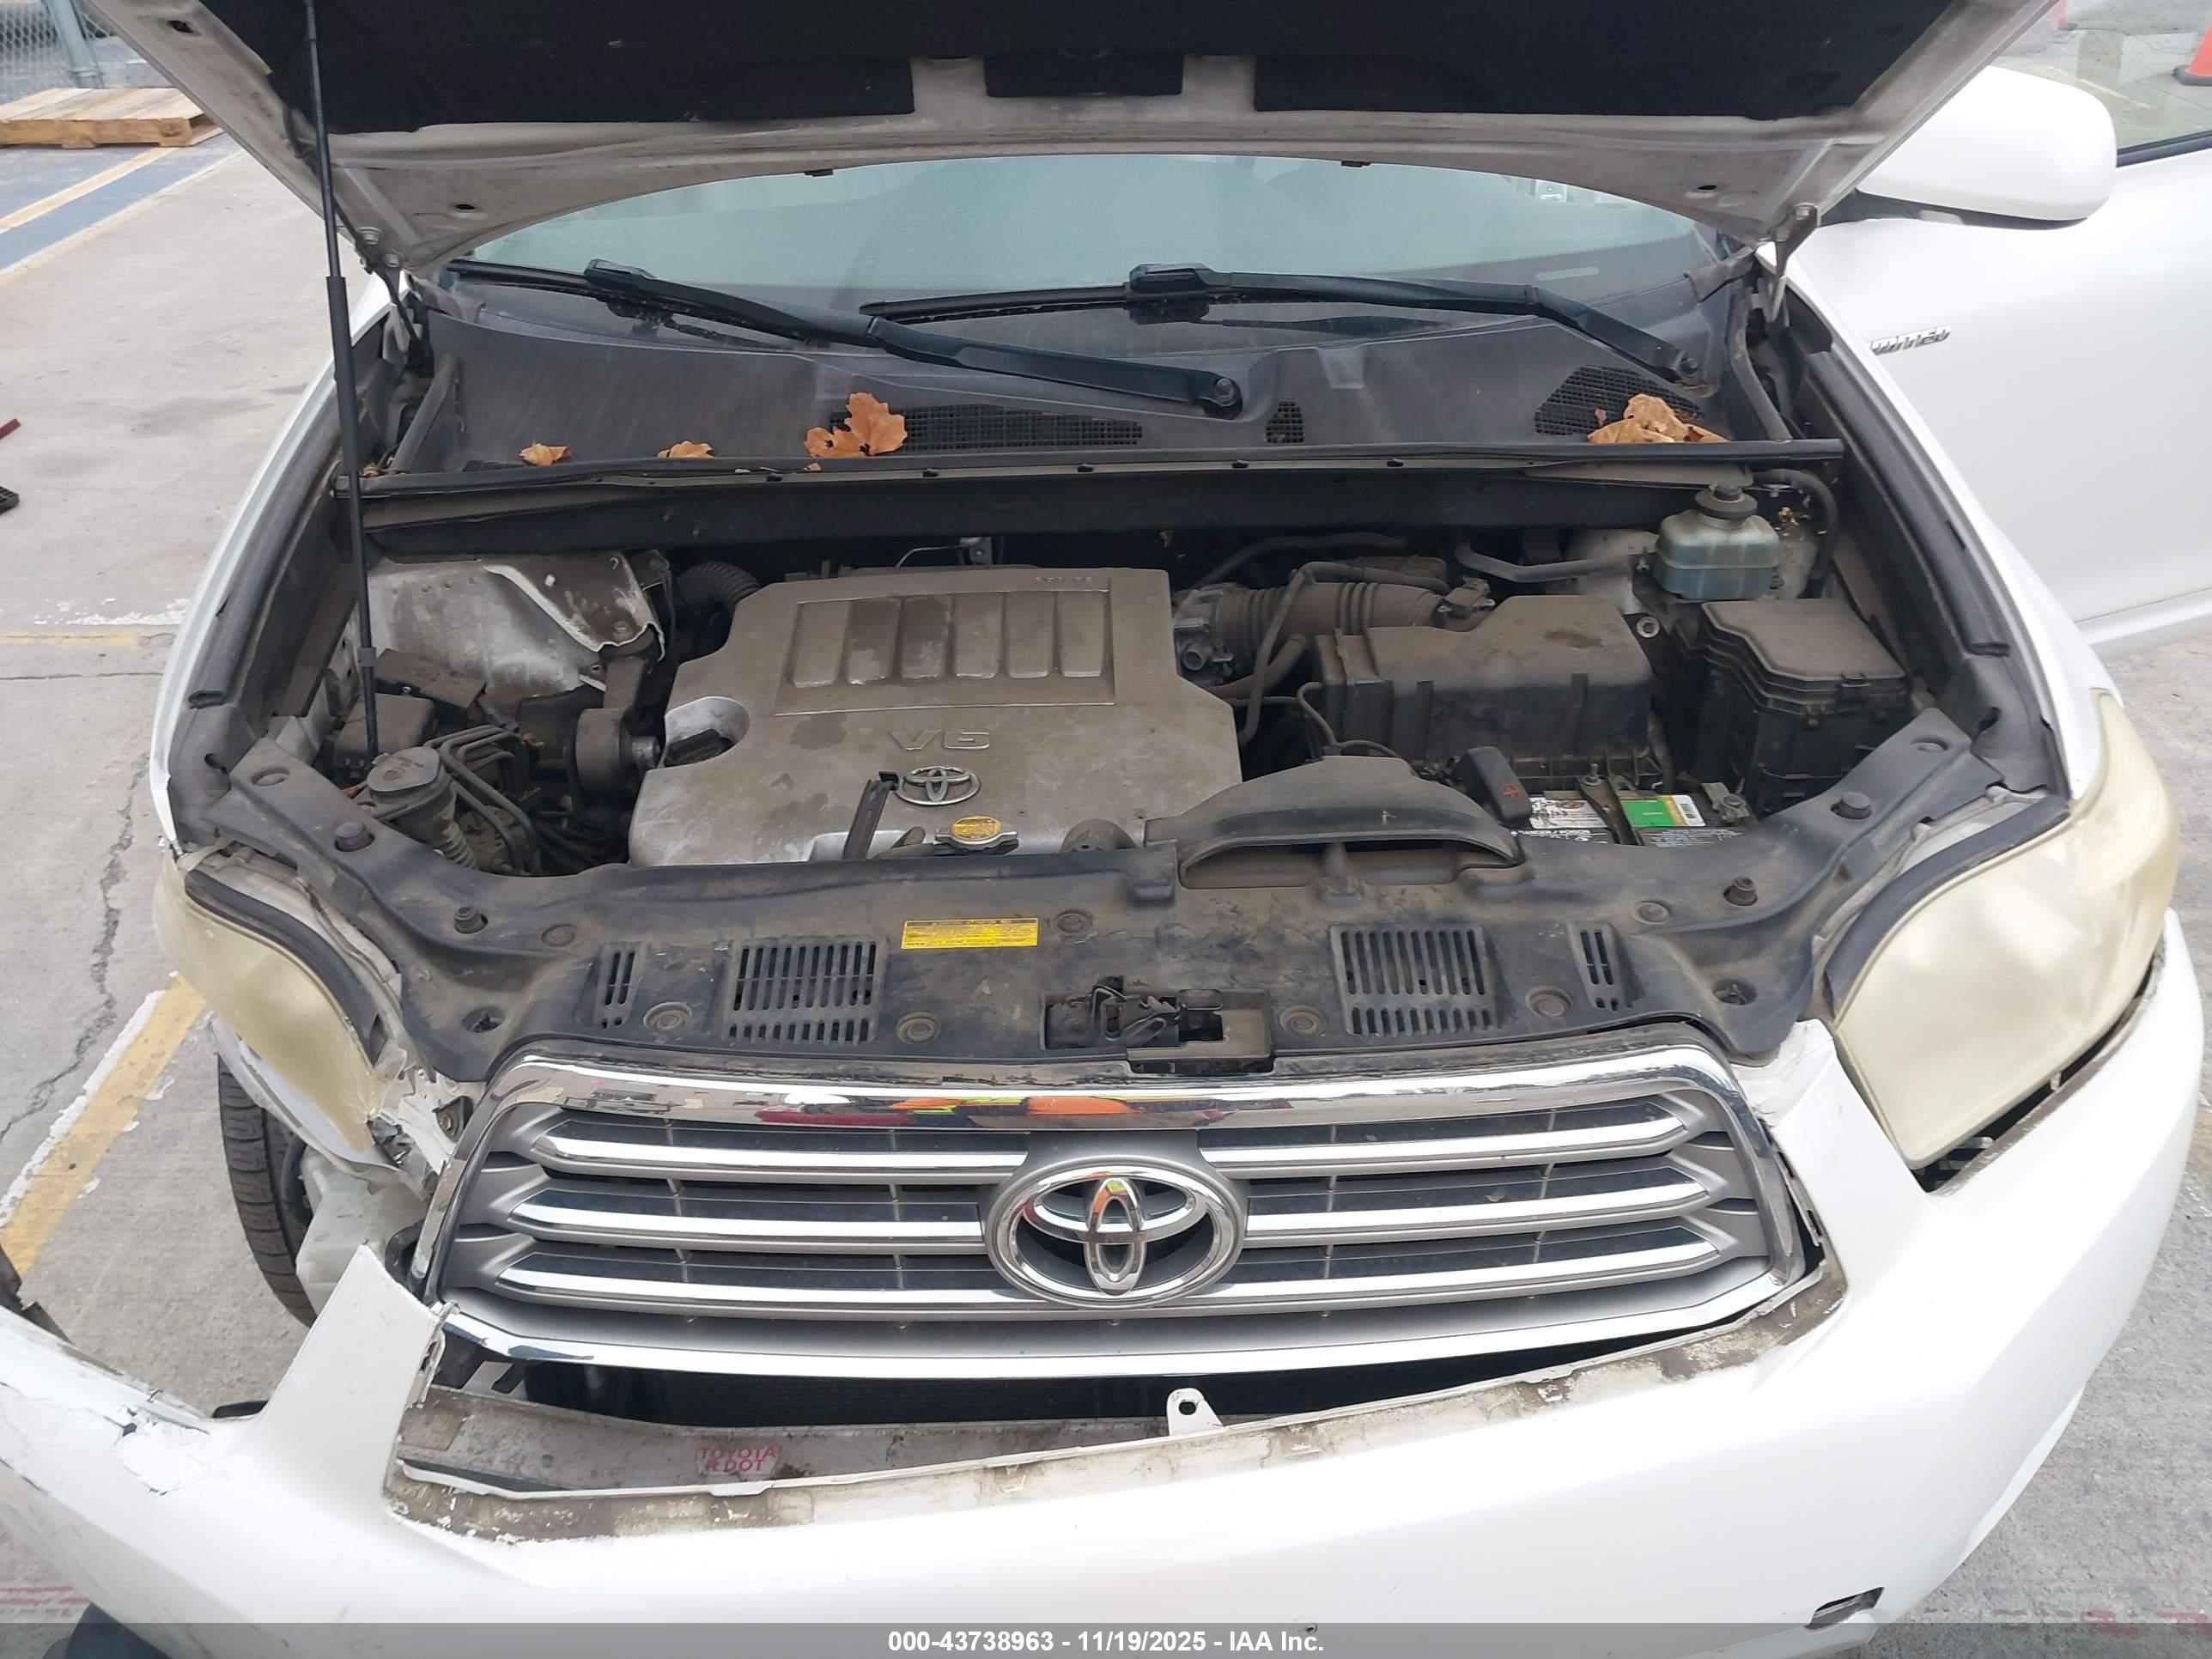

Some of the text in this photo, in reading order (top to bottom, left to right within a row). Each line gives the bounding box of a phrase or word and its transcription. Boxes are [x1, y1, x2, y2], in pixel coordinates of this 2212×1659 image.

[887, 729, 990, 750] V6
[699, 1443, 777, 1460] TOYOTA
[724, 1459, 767, 1473] DOT
